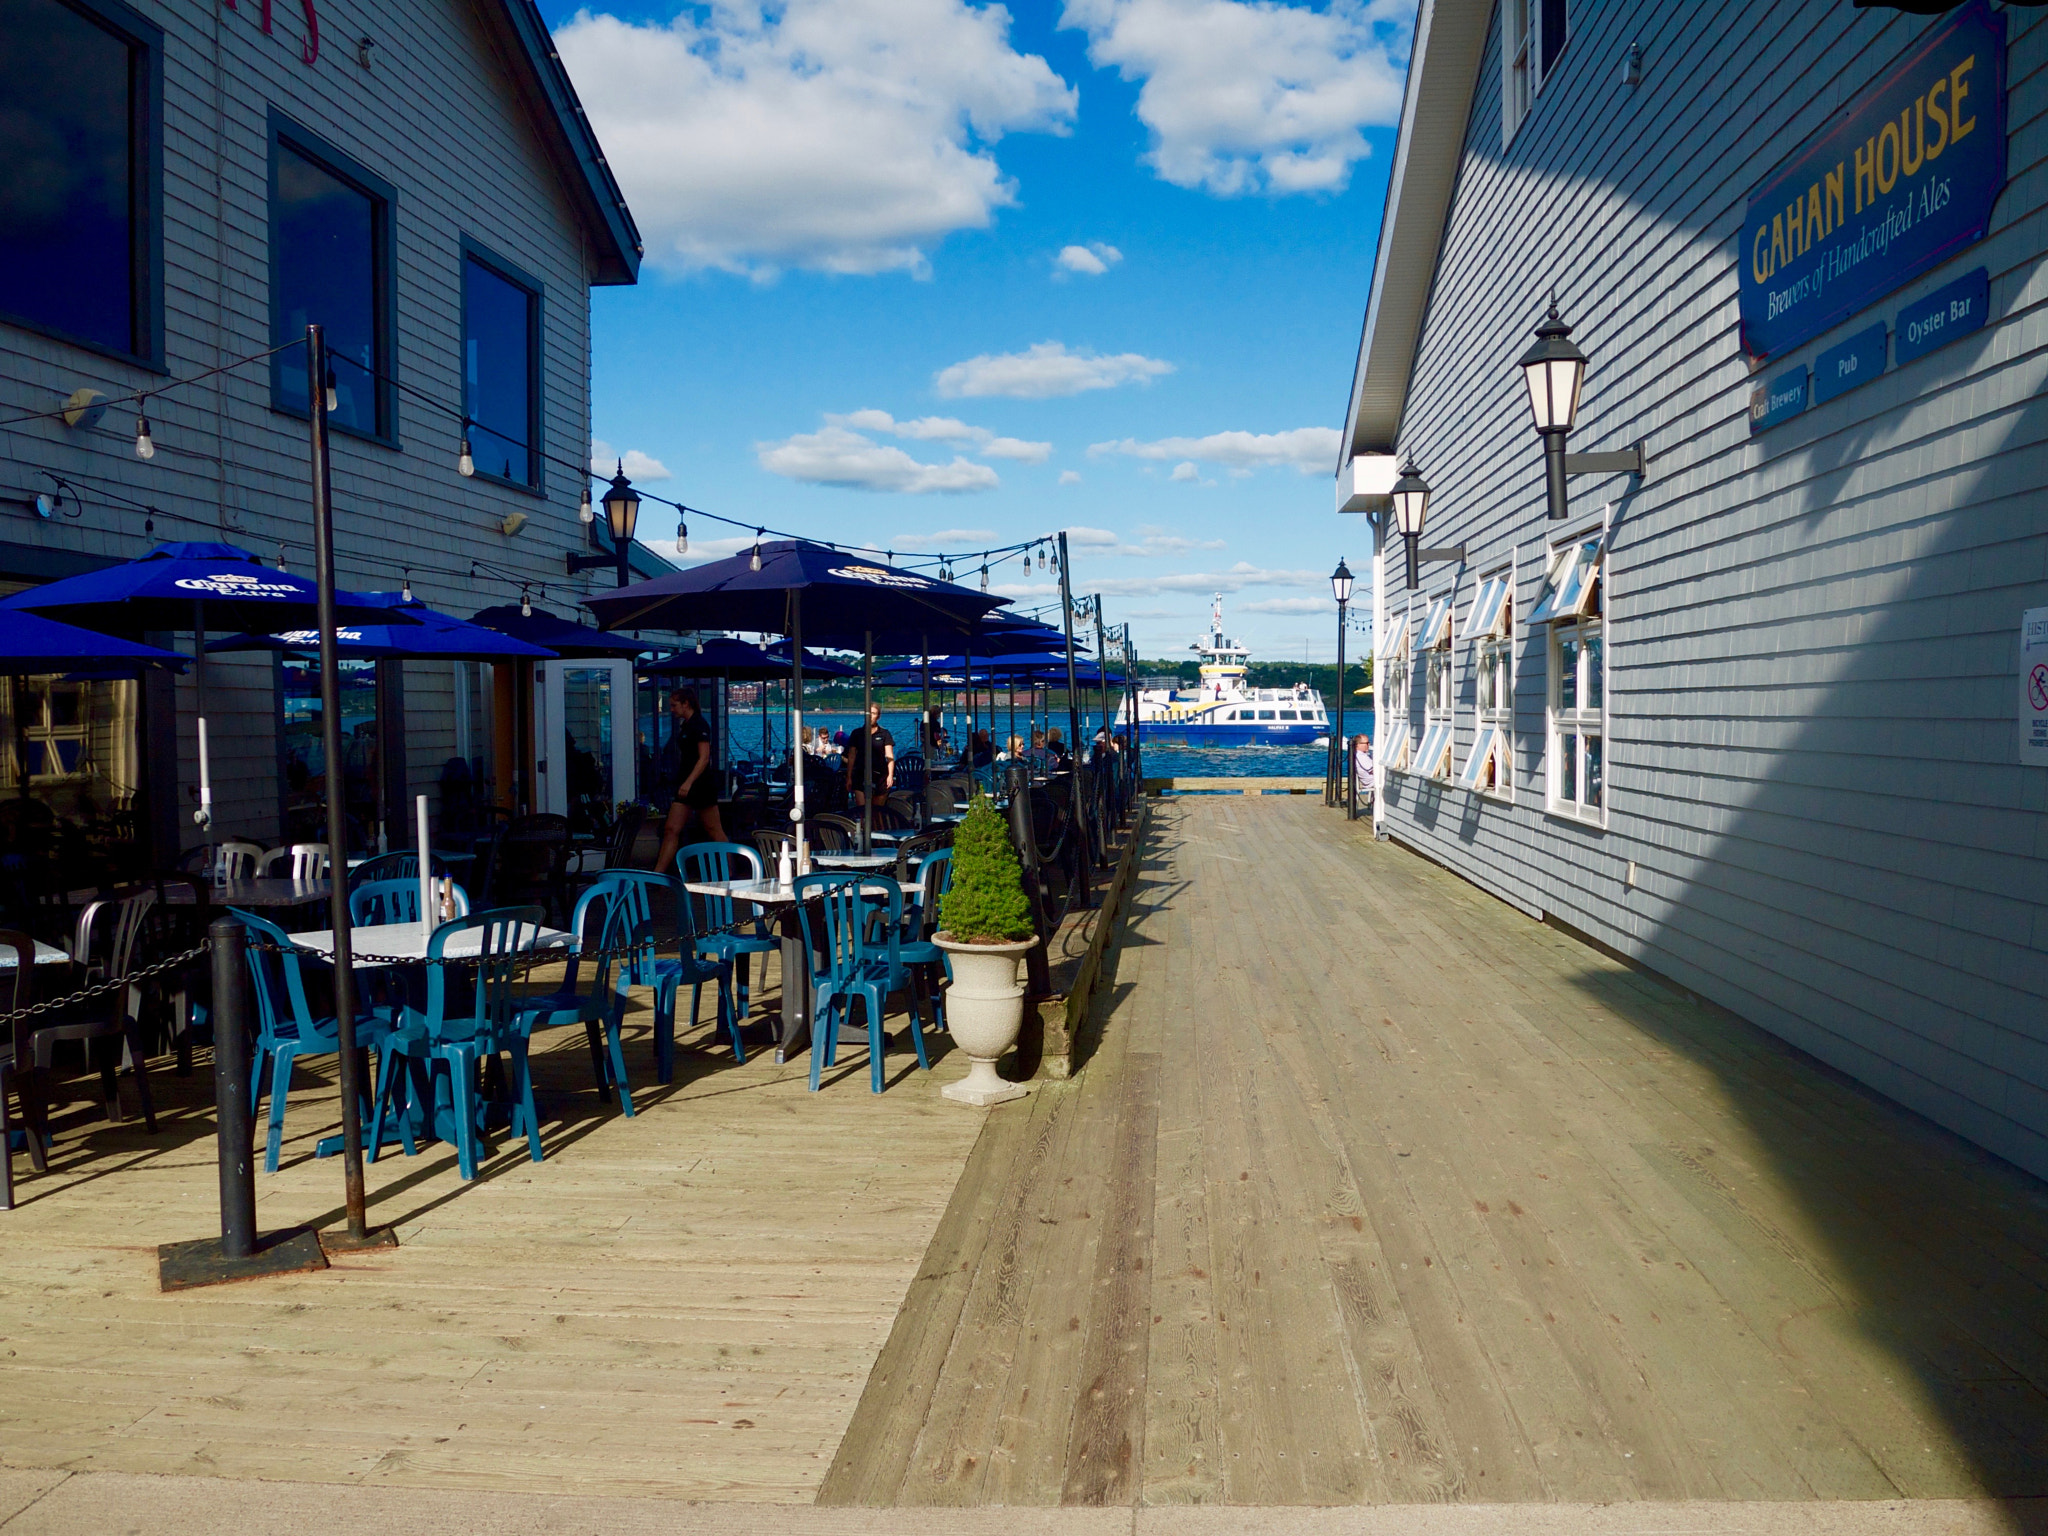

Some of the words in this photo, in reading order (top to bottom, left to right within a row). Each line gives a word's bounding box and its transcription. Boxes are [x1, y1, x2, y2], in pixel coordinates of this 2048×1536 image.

[1753, 162, 1845, 285] GAHAN
[1855, 54, 1976, 215] HOUSE
[1768, 275, 1810, 321] Brewers
[1812, 252, 1827, 298] of
[1828, 191, 1913, 282] Handcrafted
[1916, 175, 1951, 224] Ales
[1908, 310, 1946, 344] Oyster
[1950, 297, 1972, 322] Bar
[1838, 354, 1858, 378] Pub
[1753, 399, 1770, 420] Craft
[1771, 385, 1803, 411] Brewery
[174, 578, 301, 593] Corona
[216, 588, 287, 598] Extra
[2026, 620, 2048, 636] HIST
